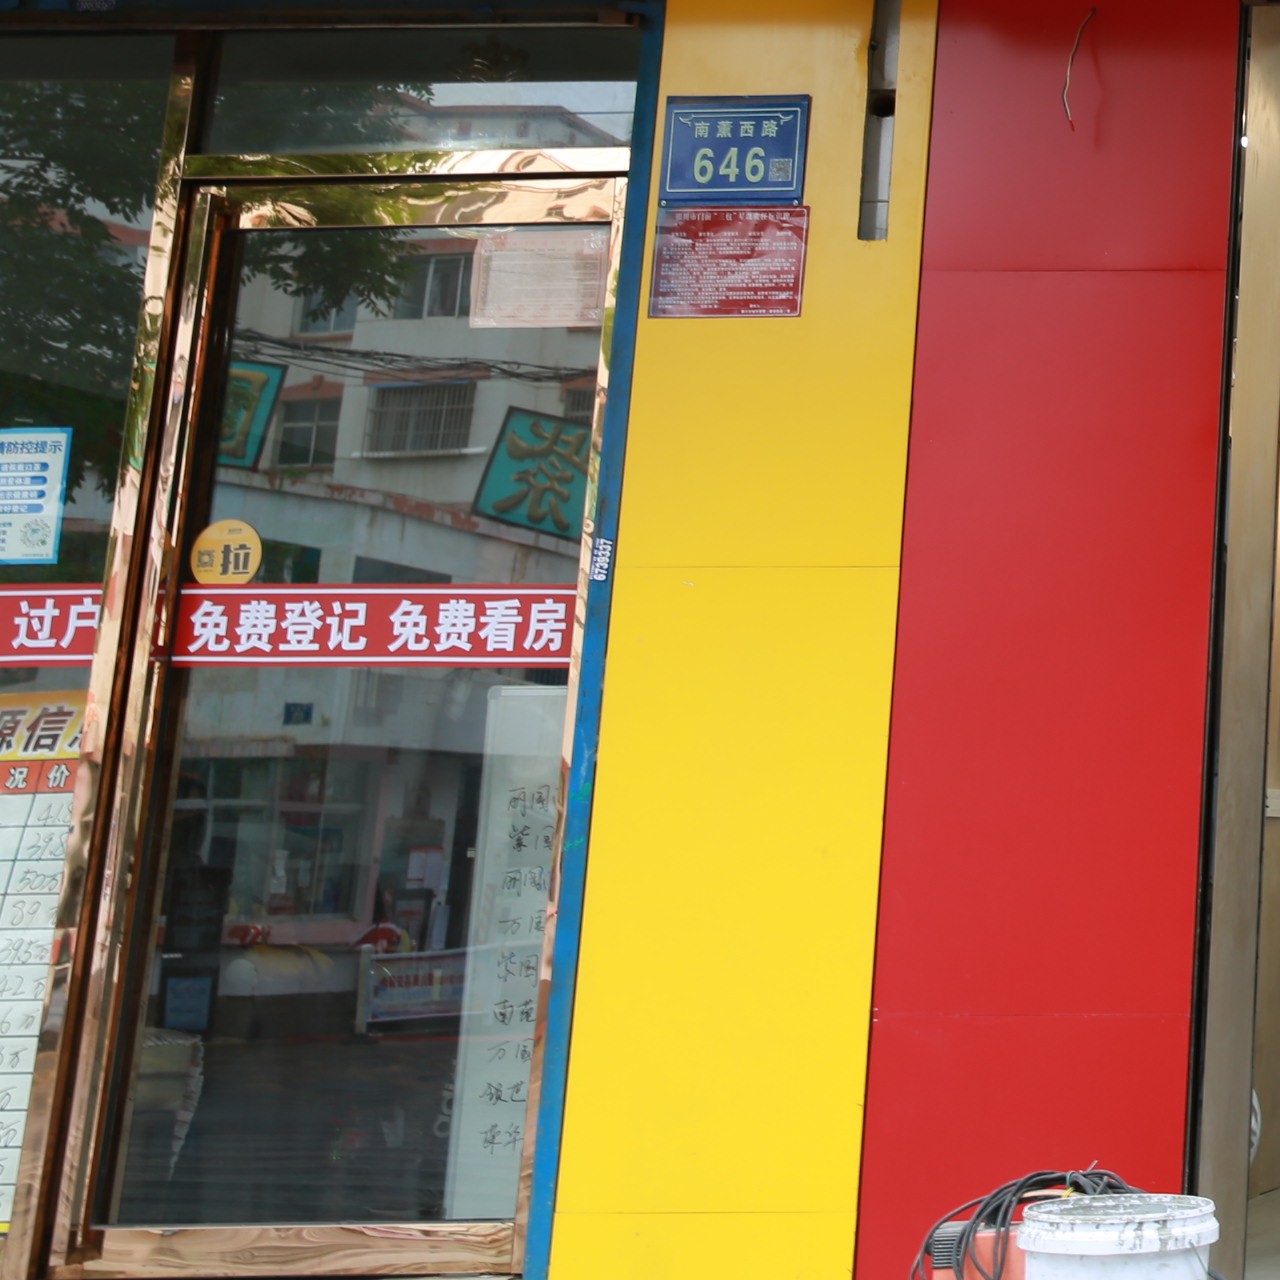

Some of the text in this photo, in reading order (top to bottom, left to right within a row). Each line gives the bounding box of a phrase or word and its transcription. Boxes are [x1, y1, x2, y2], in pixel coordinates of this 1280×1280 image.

[694, 119, 779, 138] 南薰西路
[693, 147, 766, 184] 646
[0, 440, 63, 455] 防控提示
[219, 544, 252, 576] 拉
[12, 599, 101, 650] 过户
[188, 598, 568, 653] 免费登记 免费看房
[5, 763, 71, 789] 况 价
